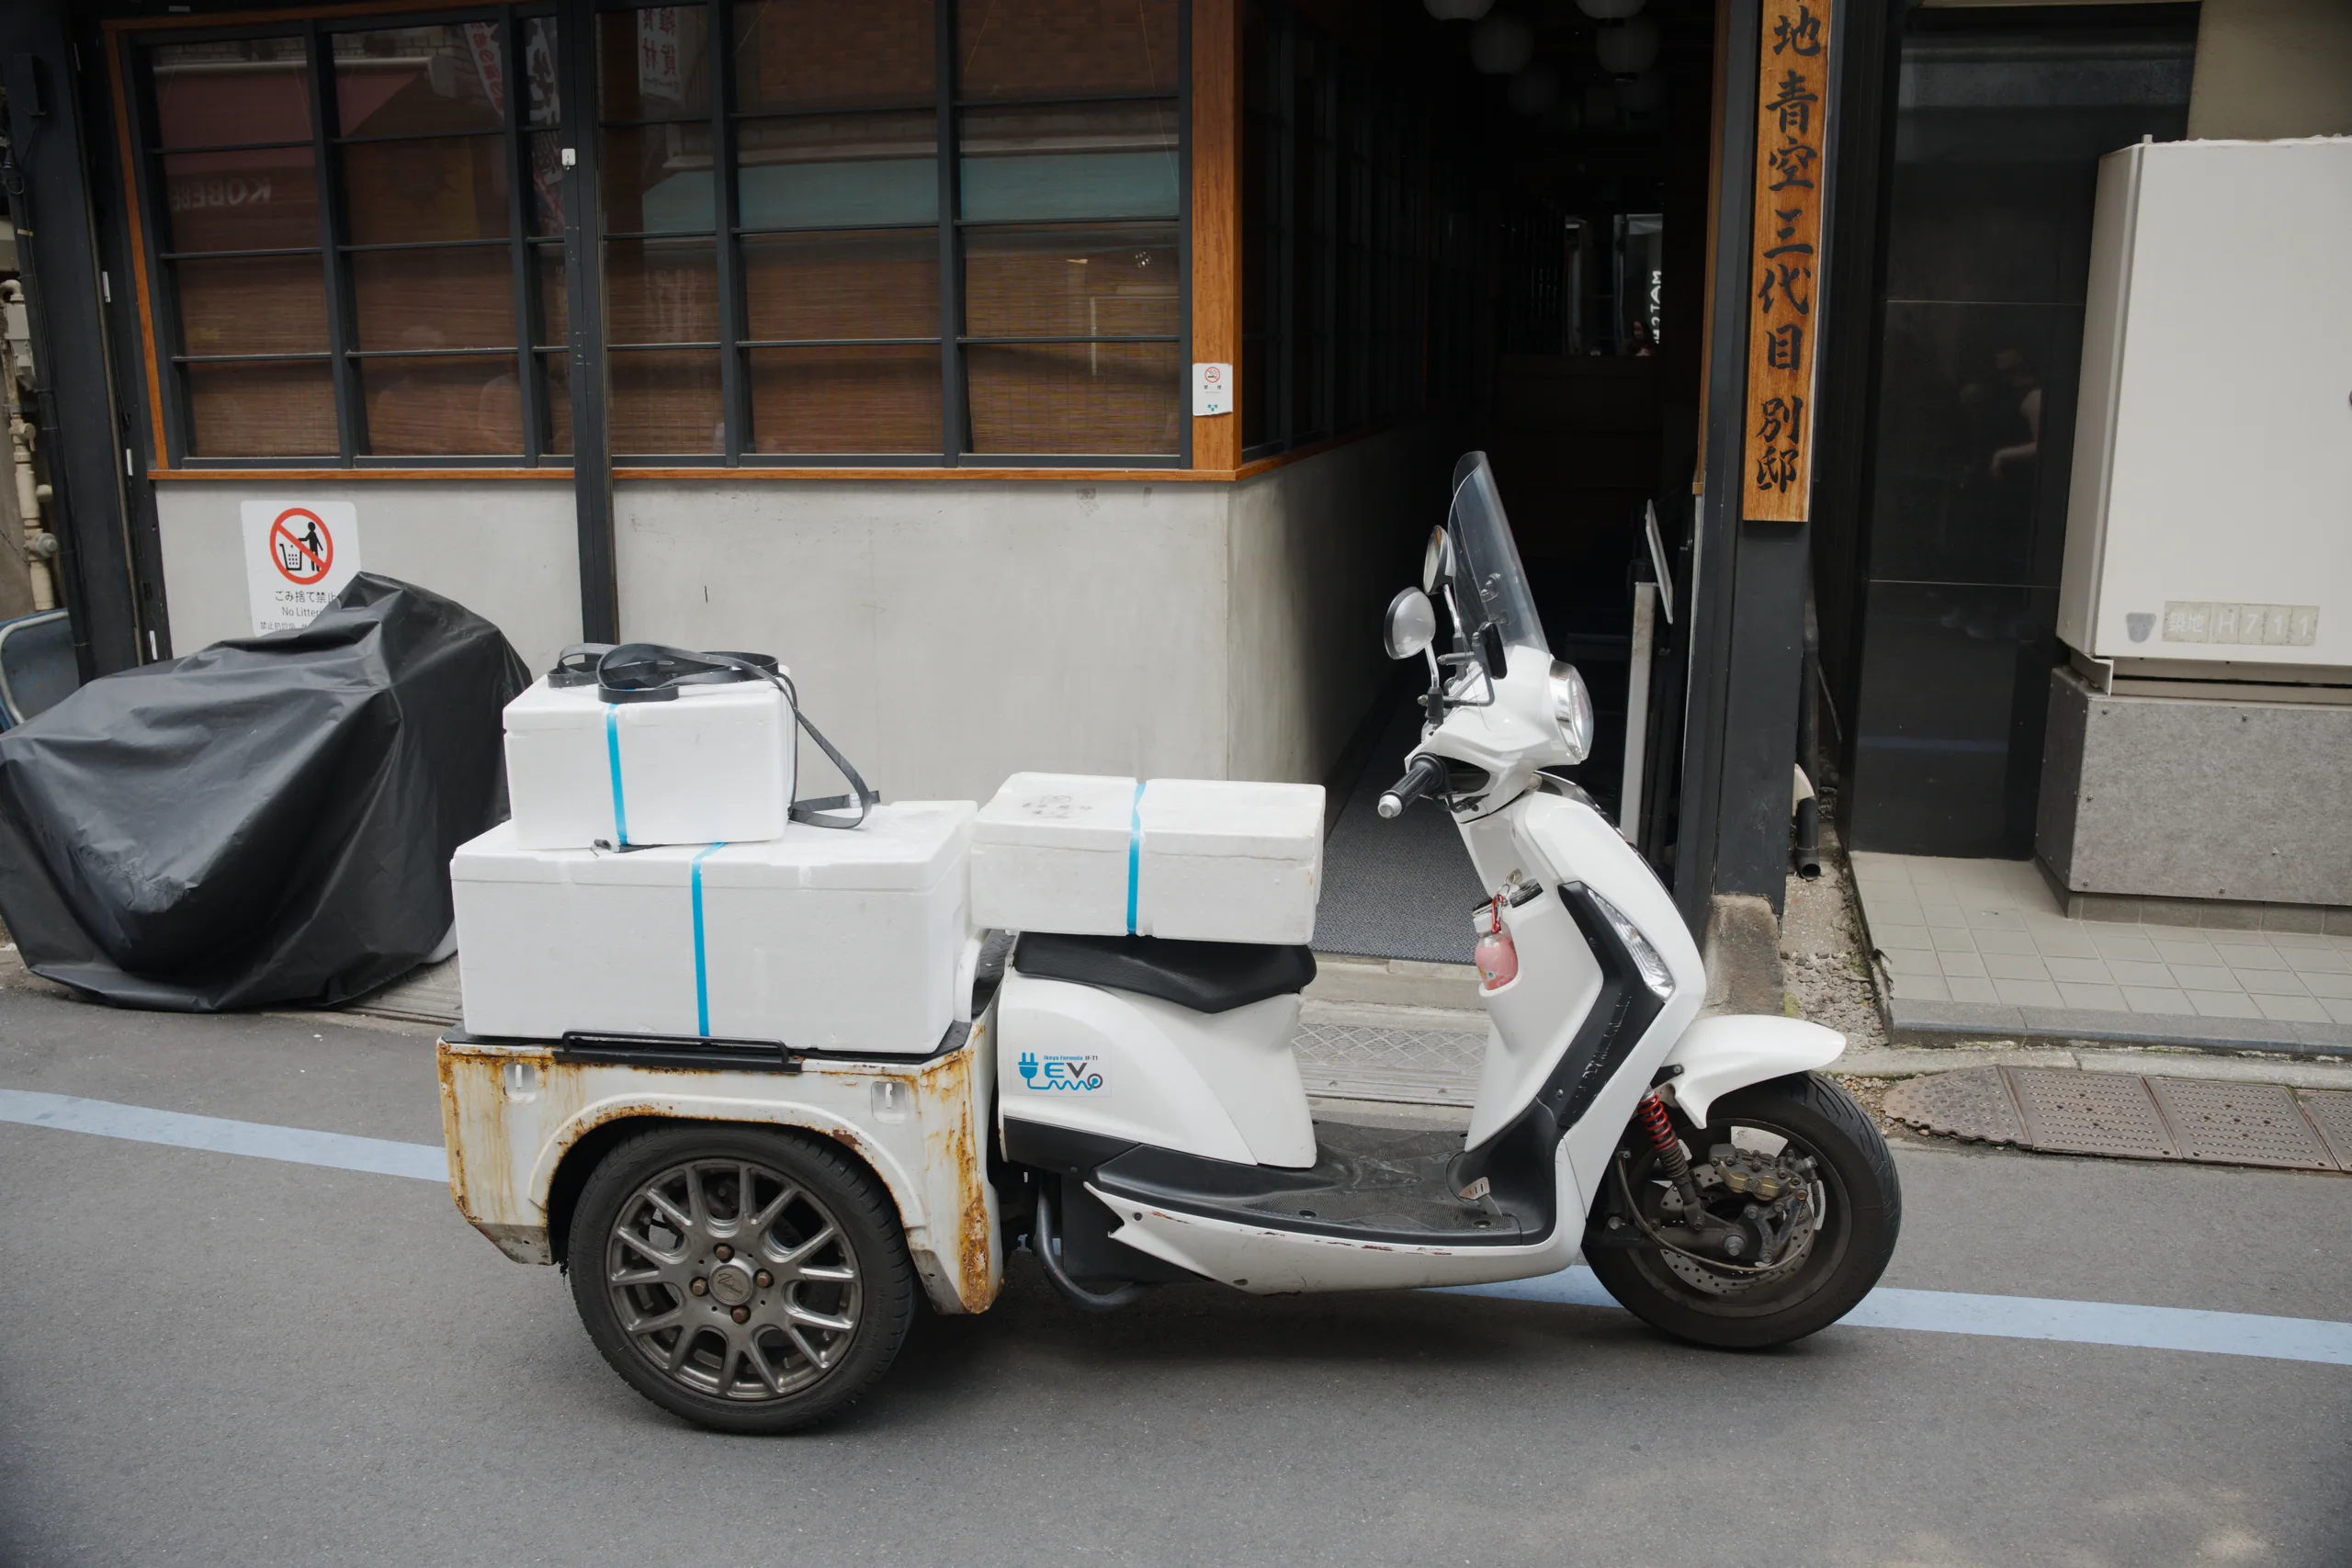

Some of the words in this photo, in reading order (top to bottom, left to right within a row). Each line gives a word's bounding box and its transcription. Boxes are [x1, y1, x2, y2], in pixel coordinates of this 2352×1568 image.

[1756, 0, 1821, 493] 地青空三代目別邸
[275, 591, 336, 603] ごみ捨て禁止
[282, 606, 294, 616] No
[2168, 612, 2204, 633] 築地
